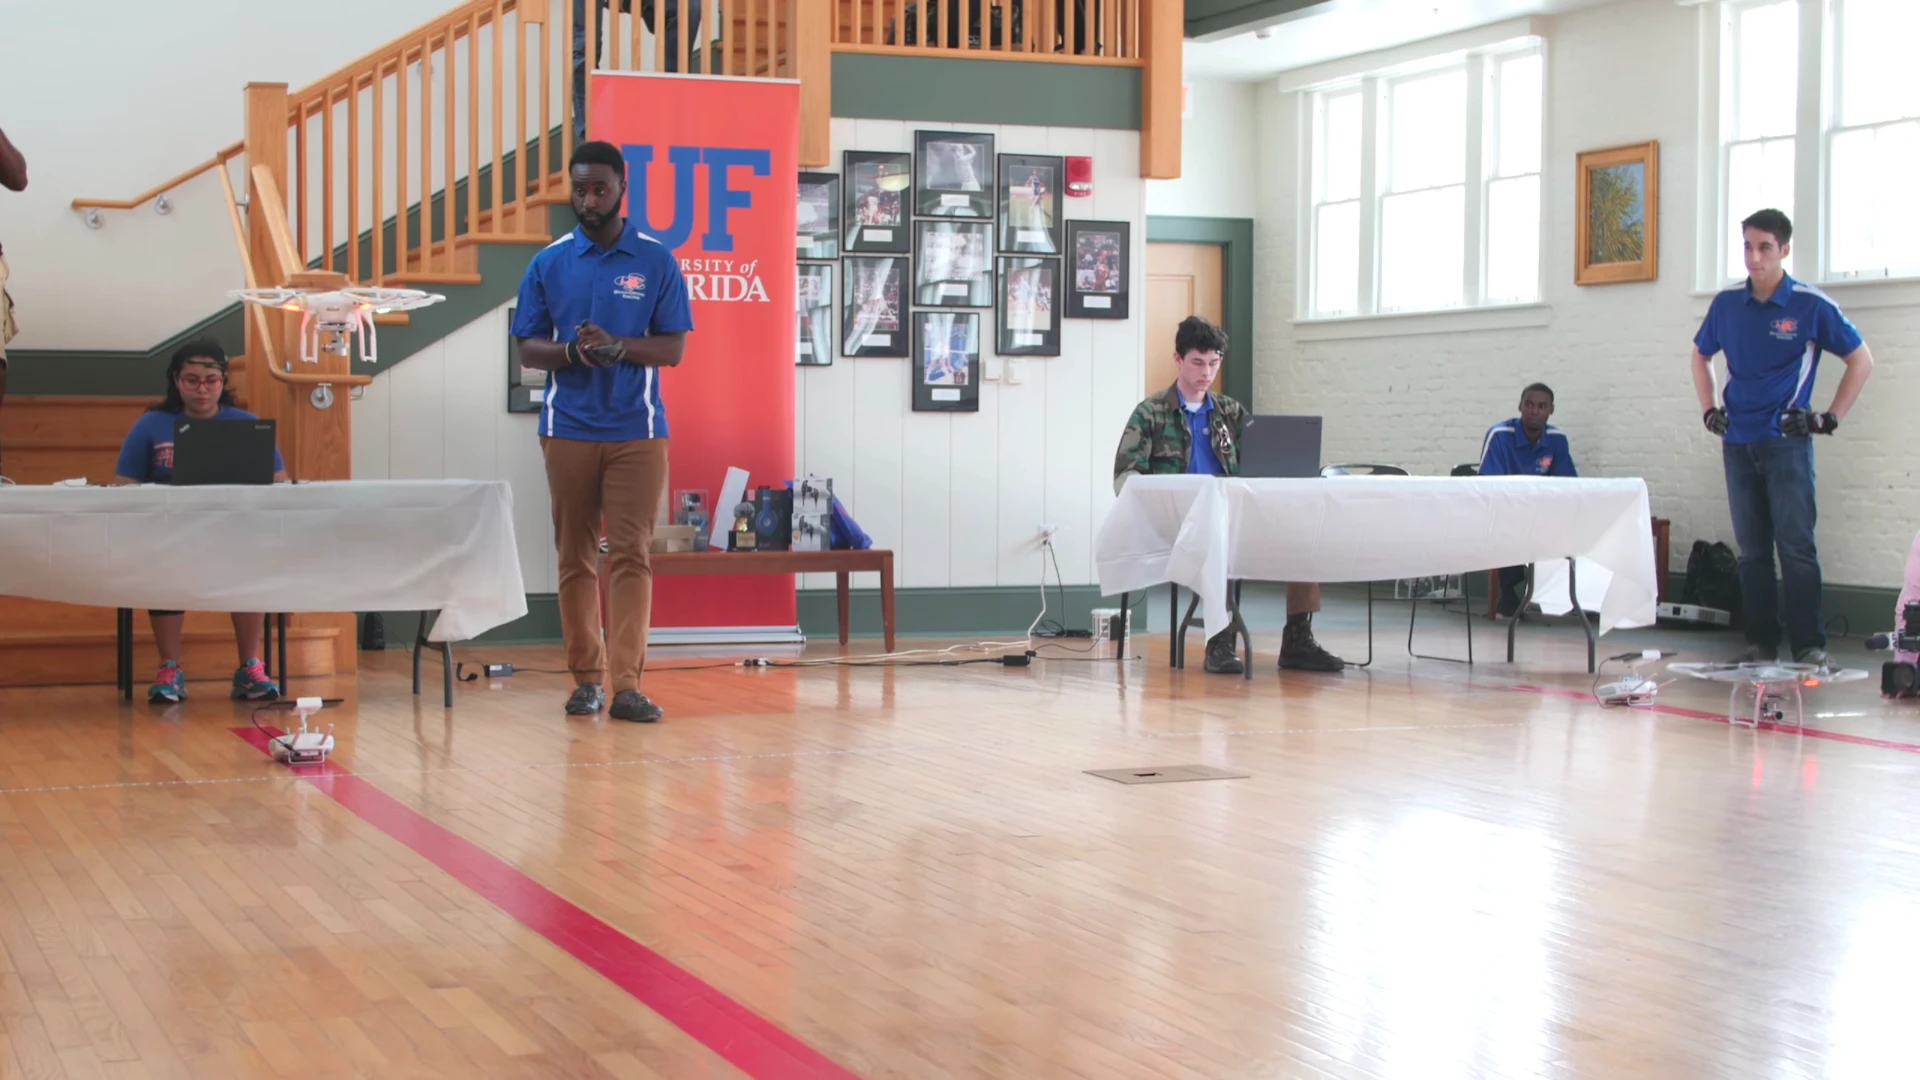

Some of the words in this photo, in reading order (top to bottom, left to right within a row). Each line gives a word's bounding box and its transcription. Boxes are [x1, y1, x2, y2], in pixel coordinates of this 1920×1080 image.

[622, 144, 770, 251] UF
[680, 259, 733, 272] RSITY
[740, 260, 758, 278] of
[685, 274, 770, 302] RIDA
